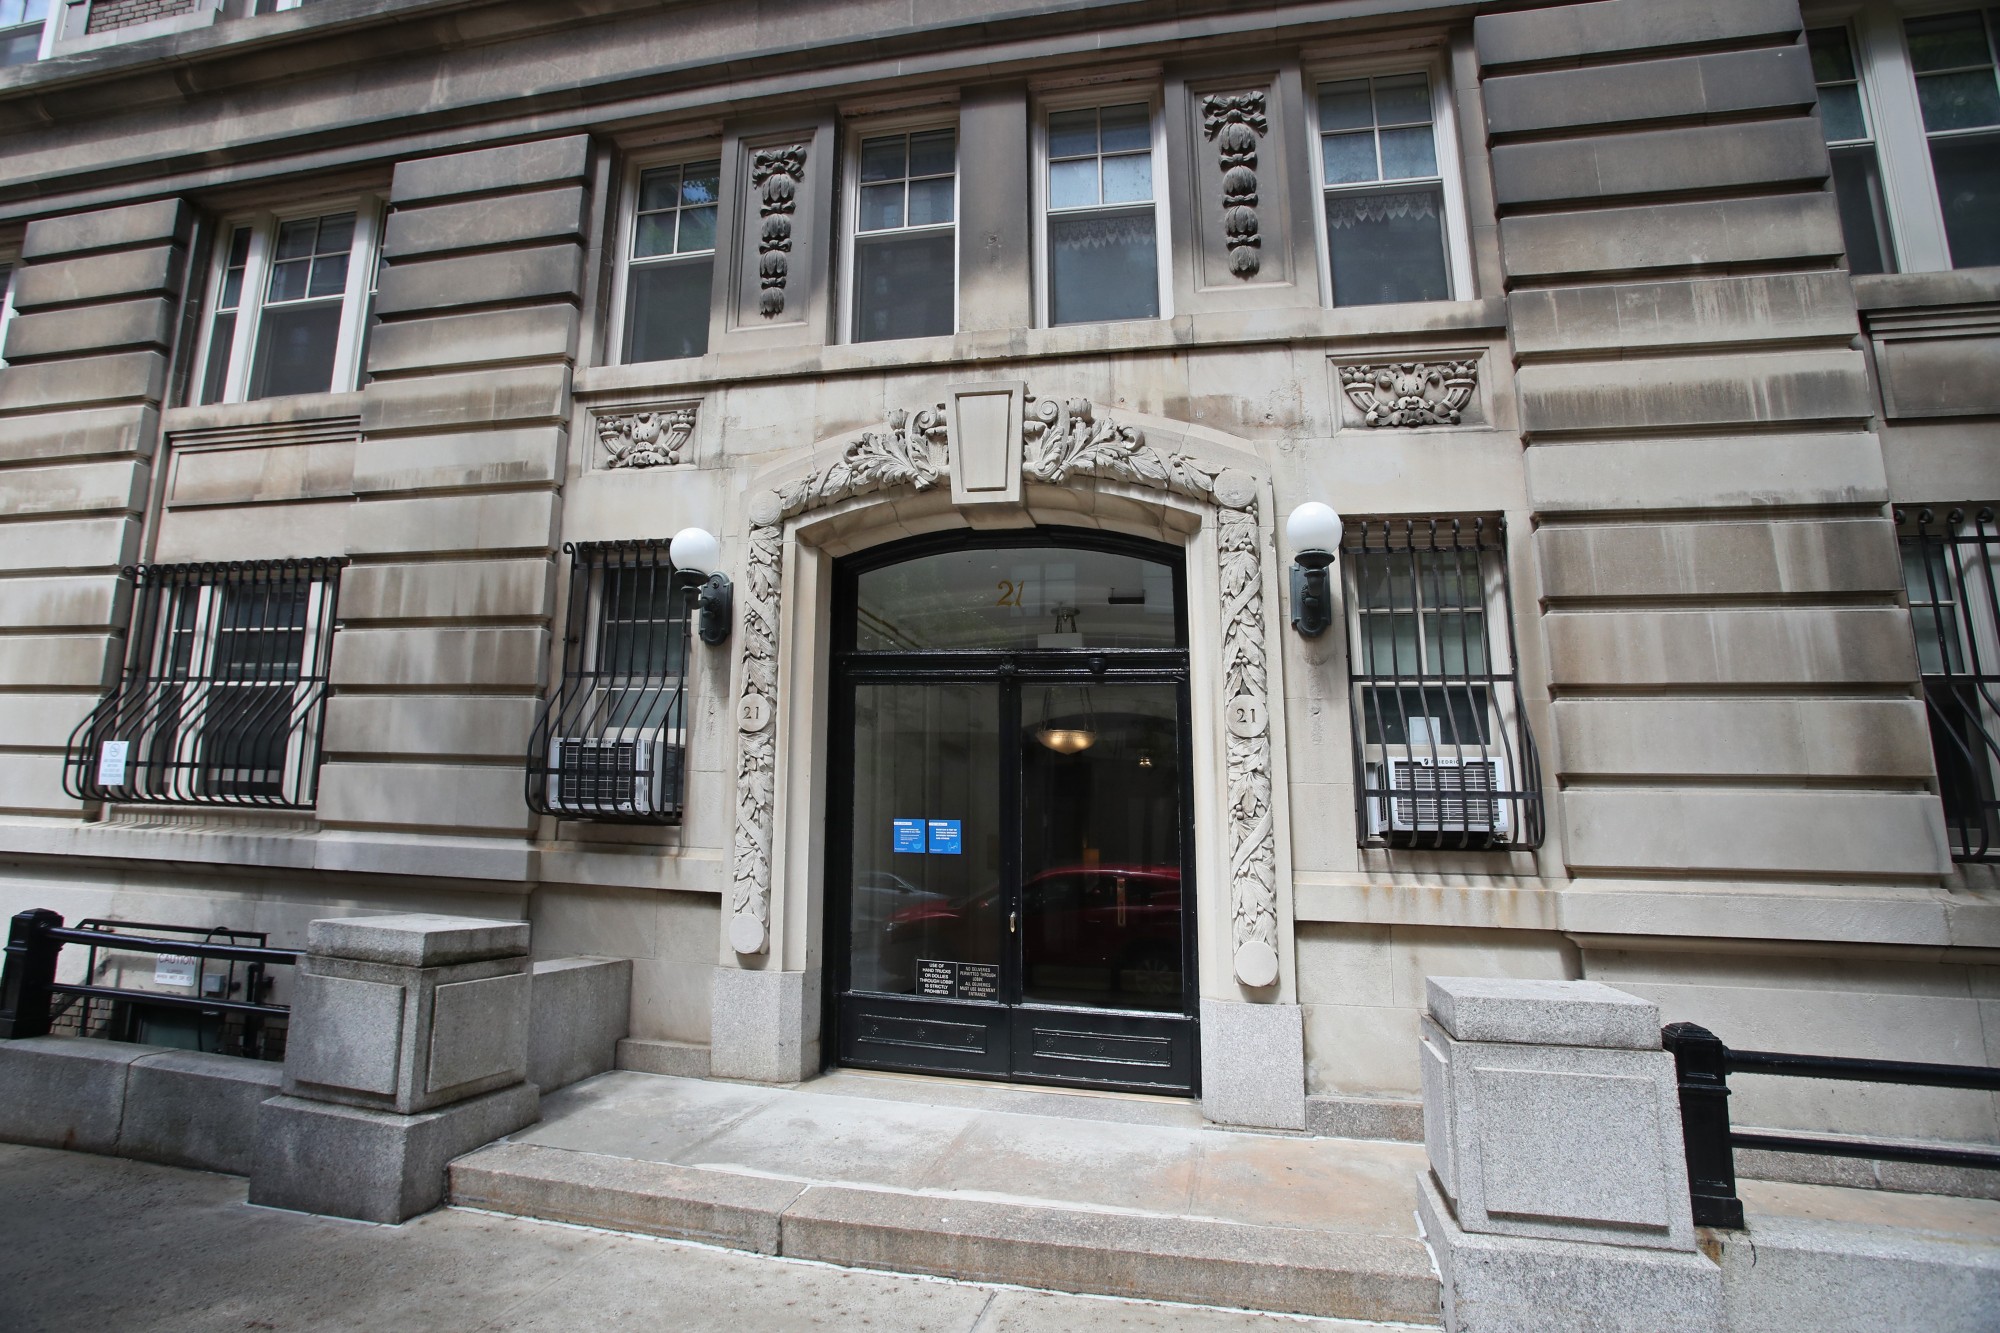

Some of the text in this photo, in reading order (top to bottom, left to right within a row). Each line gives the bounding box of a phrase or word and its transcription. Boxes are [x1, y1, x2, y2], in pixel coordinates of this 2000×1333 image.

[996, 580, 1024, 607] 21
[743, 706, 759, 720] 21
[1236, 708, 1256, 723] 21
[159, 954, 195, 965] CAUTION
